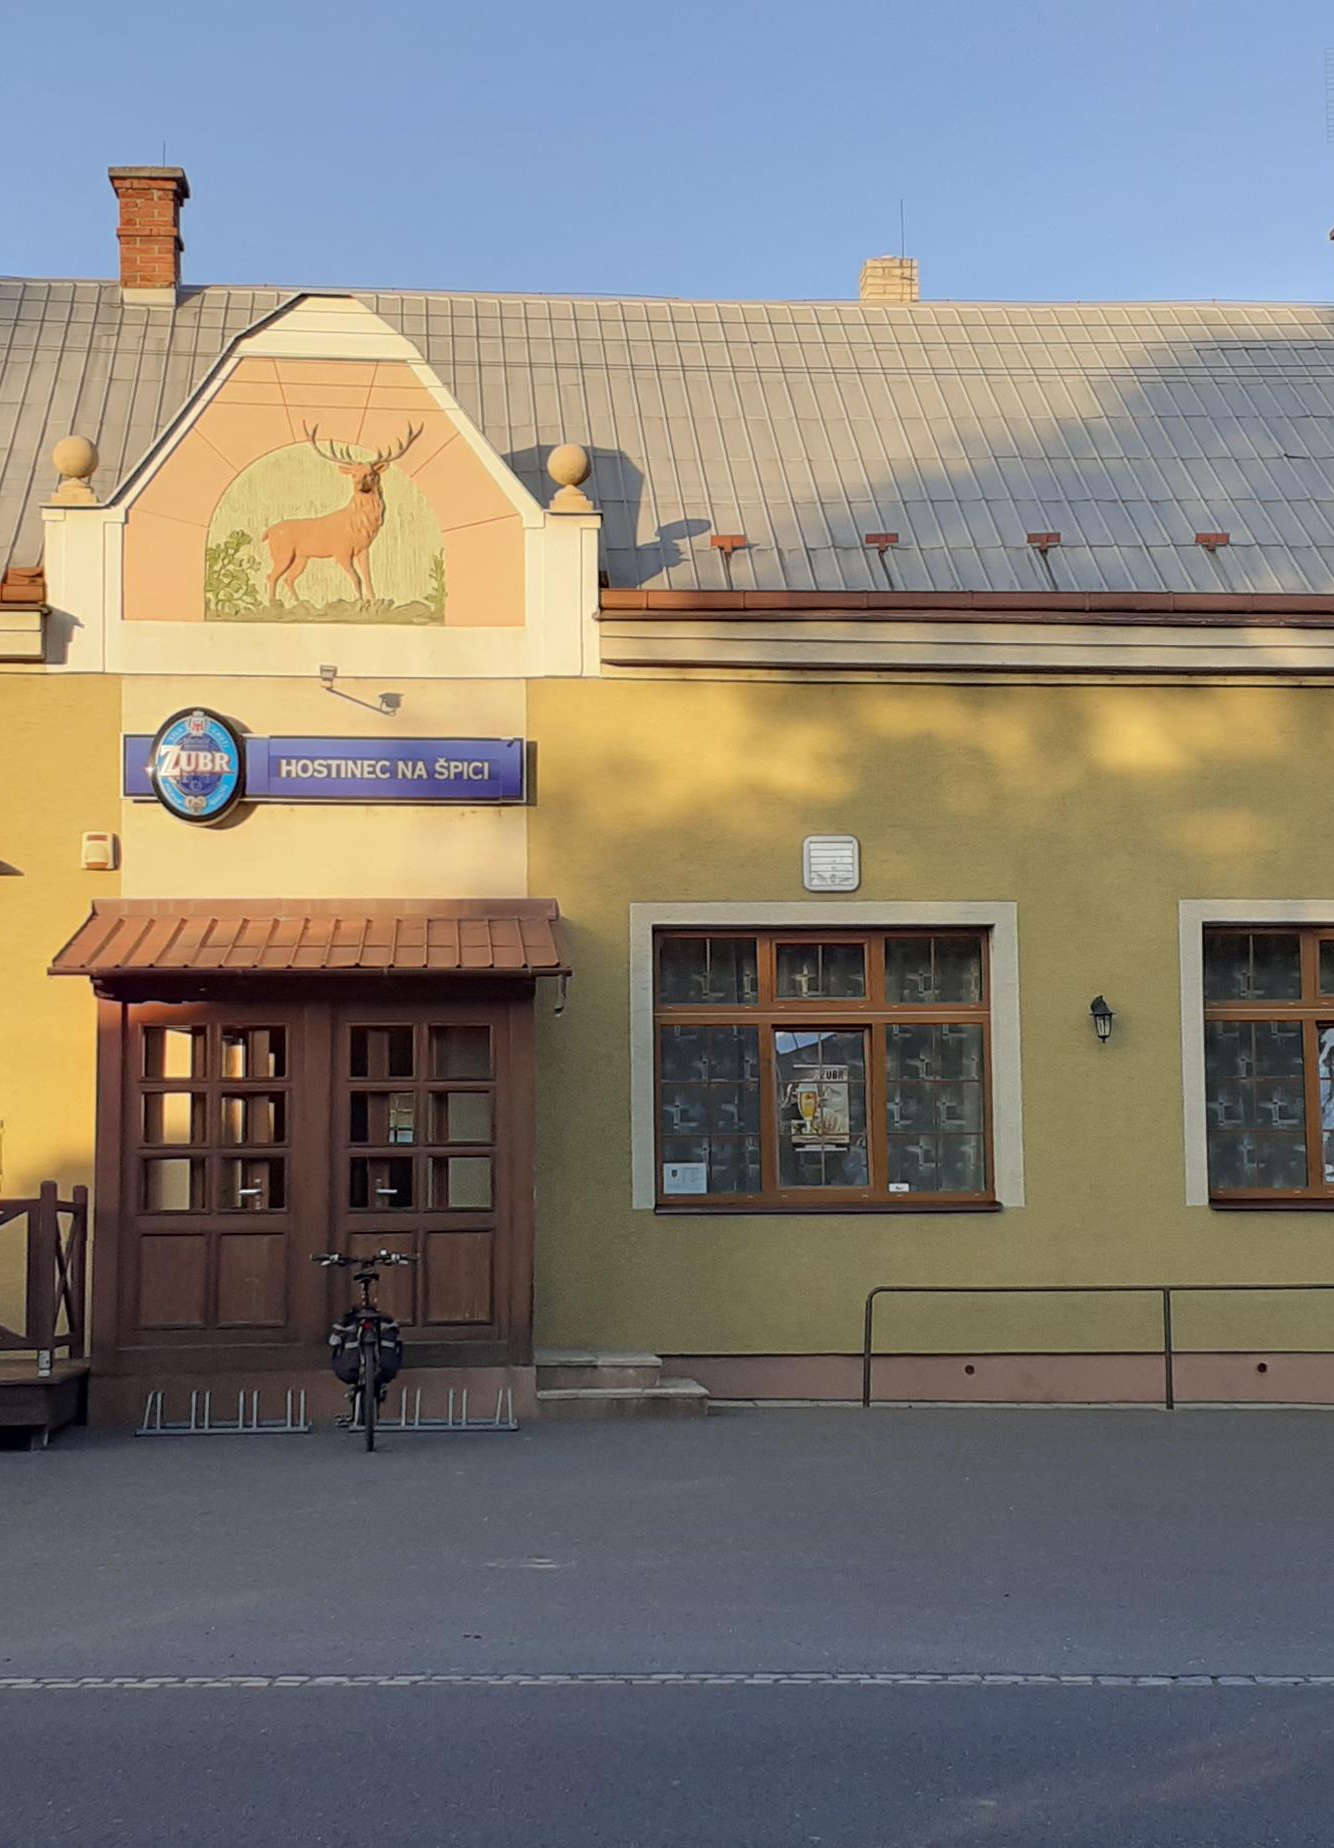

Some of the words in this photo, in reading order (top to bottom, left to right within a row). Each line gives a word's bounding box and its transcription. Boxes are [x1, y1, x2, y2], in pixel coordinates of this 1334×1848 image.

[160, 745, 231, 776] ZUBR
[280, 759, 391, 779] HOSTINEC
[397, 760, 428, 780] NA
[434, 757, 490, 780] ŠPICI
